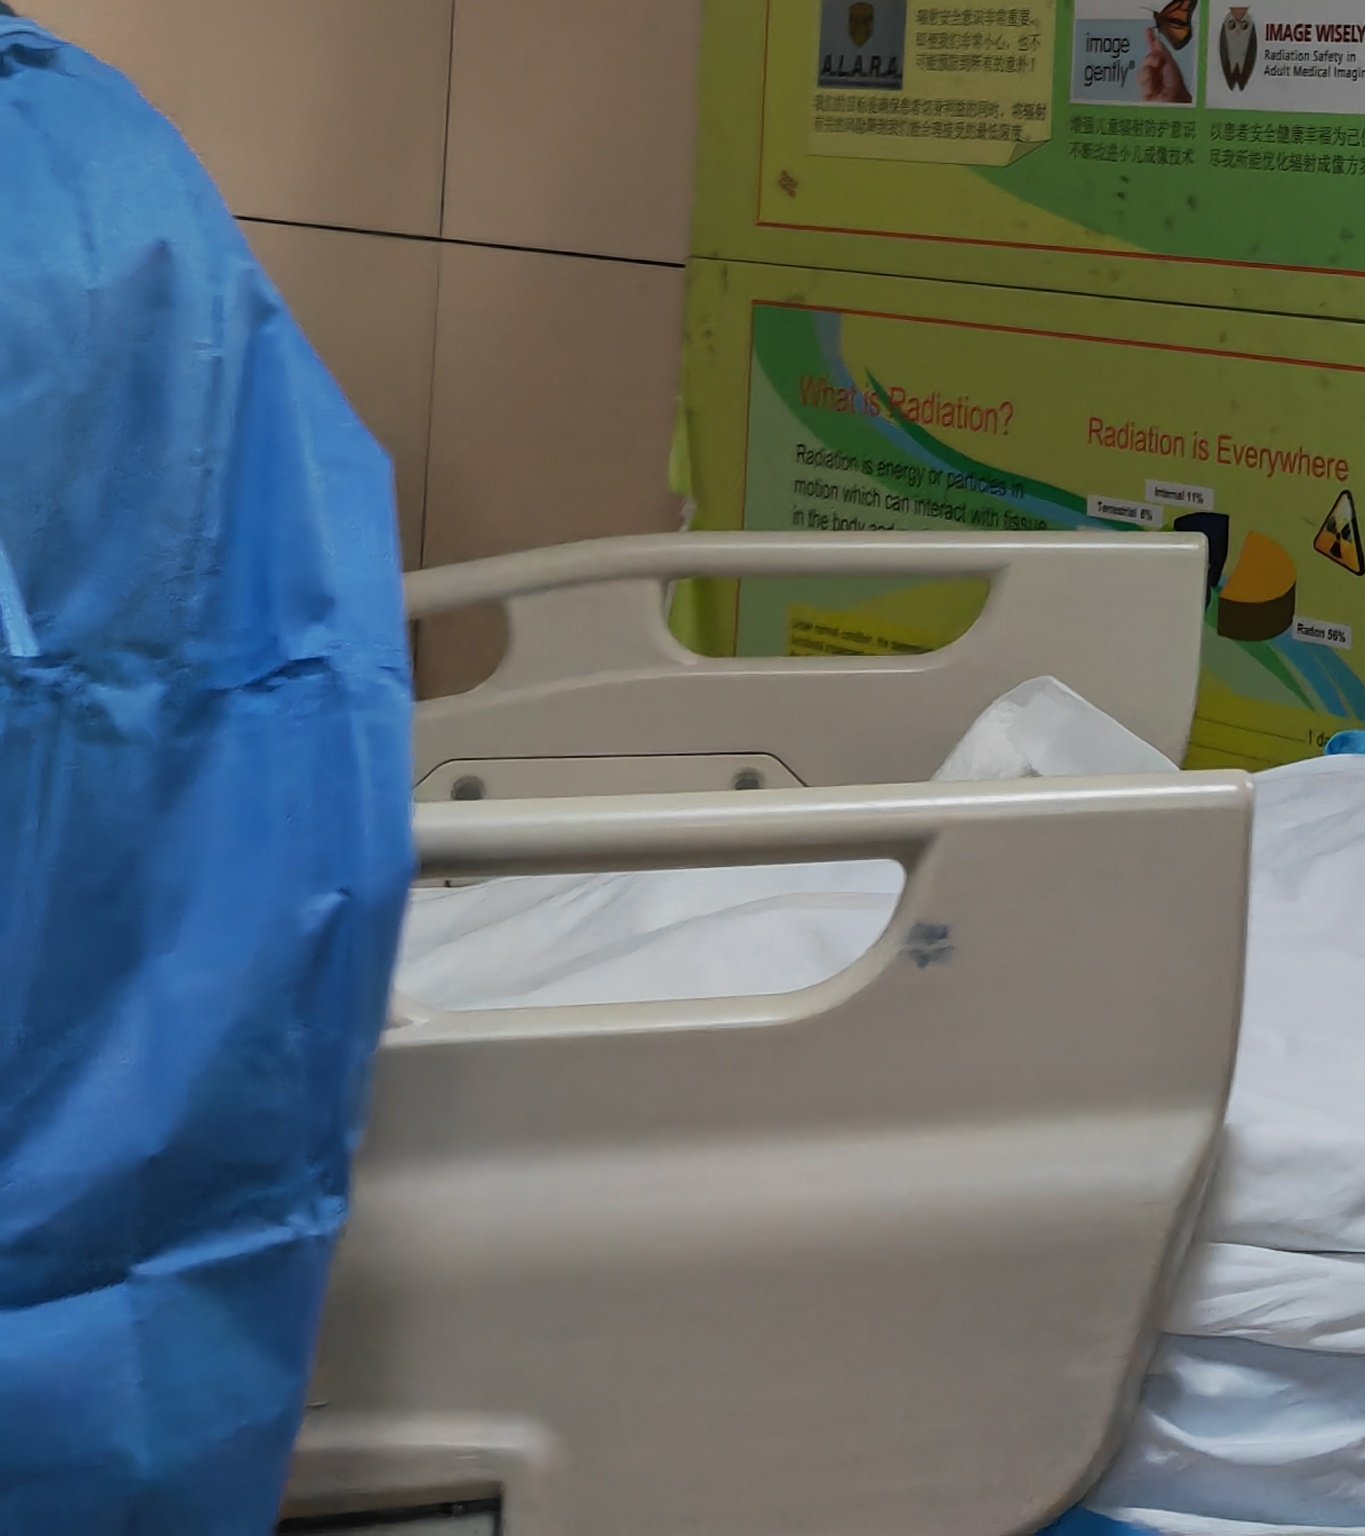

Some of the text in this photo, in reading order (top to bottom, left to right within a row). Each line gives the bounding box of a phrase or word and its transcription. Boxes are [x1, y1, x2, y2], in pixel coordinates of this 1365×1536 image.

[1085, 32, 1131, 58] image
[1265, 23, 1312, 43] IMAGE
[1264, 49, 1357, 66] Radiation Safety in
[1264, 64, 1291, 77] Adult
[1293, 65, 1331, 78] Medical
[801, 375, 1014, 436] What is Radiation?
[1087, 416, 1350, 482] Radiation is Everywhere
[796, 444, 1025, 499] Radiation is energy or particles in
[794, 477, 1047, 531] motion which can interact with tissue
[1155, 486, 1204, 504] Internal 11%
[793, 504, 806, 526] in
[807, 506, 830, 529] the
[1296, 622, 1326, 639] Radon
